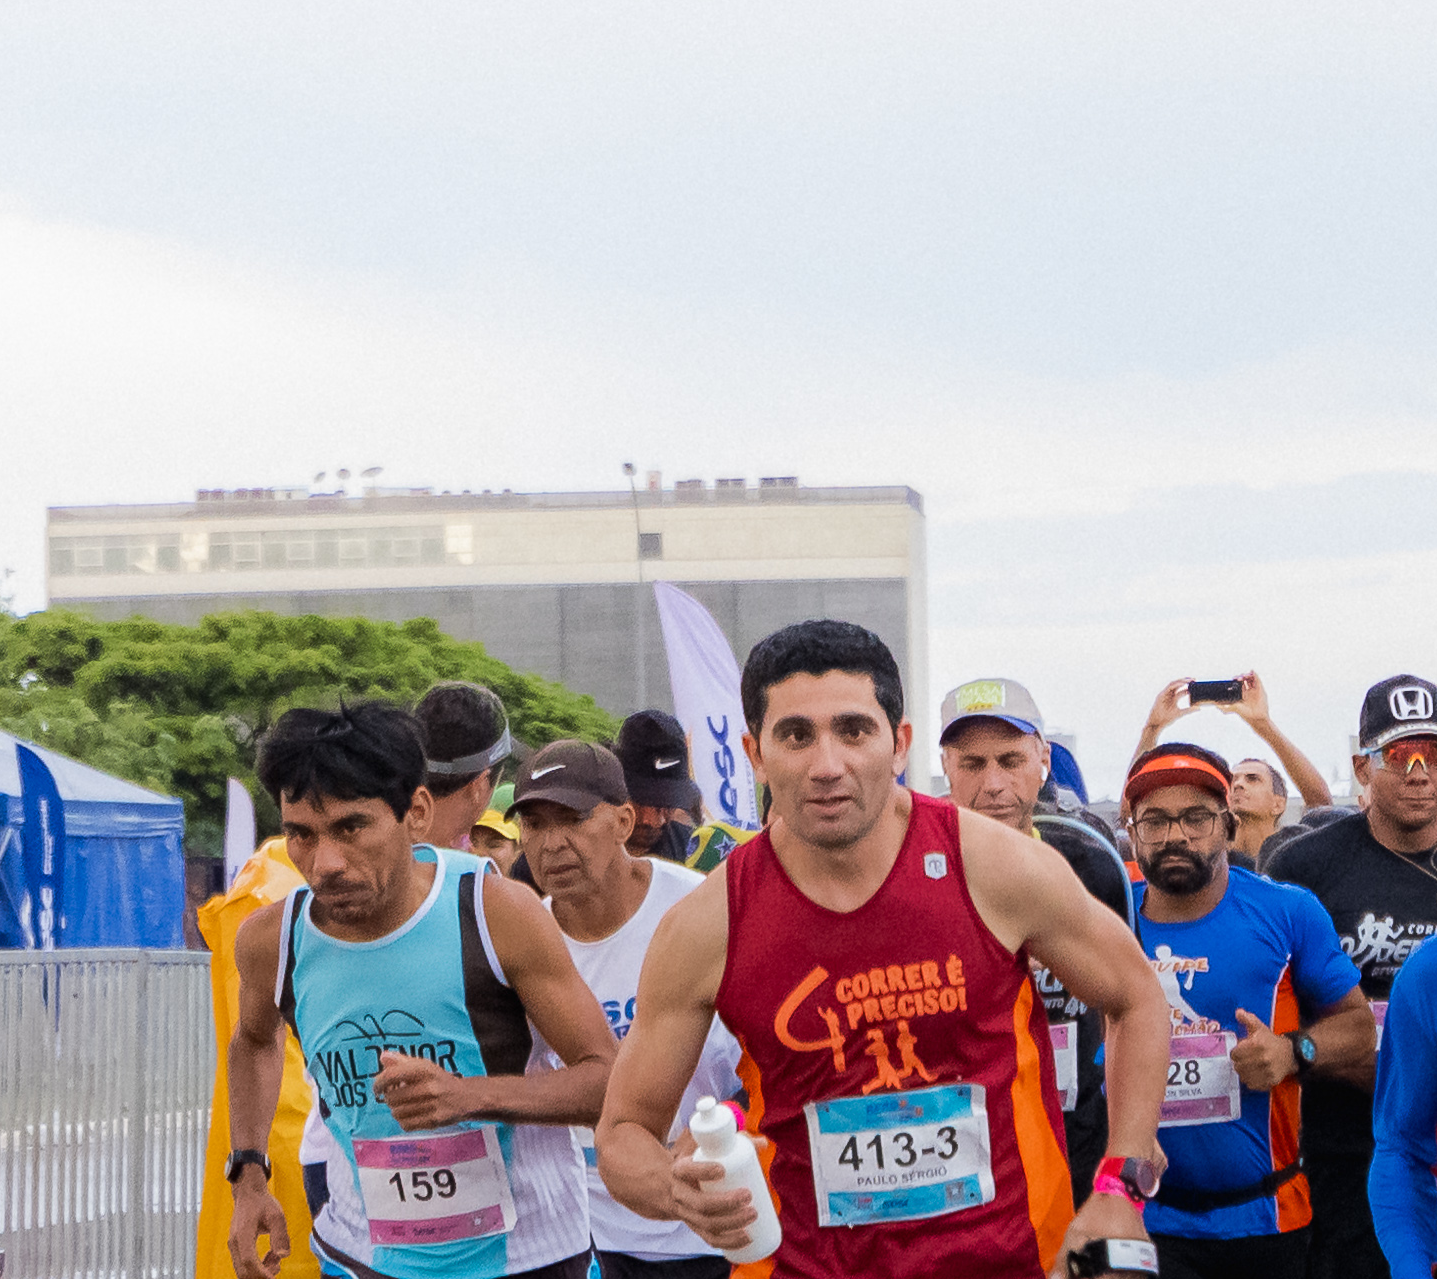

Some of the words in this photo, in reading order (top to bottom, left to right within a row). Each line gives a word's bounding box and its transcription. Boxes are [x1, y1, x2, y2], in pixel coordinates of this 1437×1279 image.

[835, 960, 942, 1004] CORRER
[946, 953, 966, 986] É
[846, 987, 967, 1030] PRECISO!
[838, 1126, 959, 1172] 413-3
[389, 1168, 457, 1202] 159
[857, 1174, 898, 1186] PAULO
